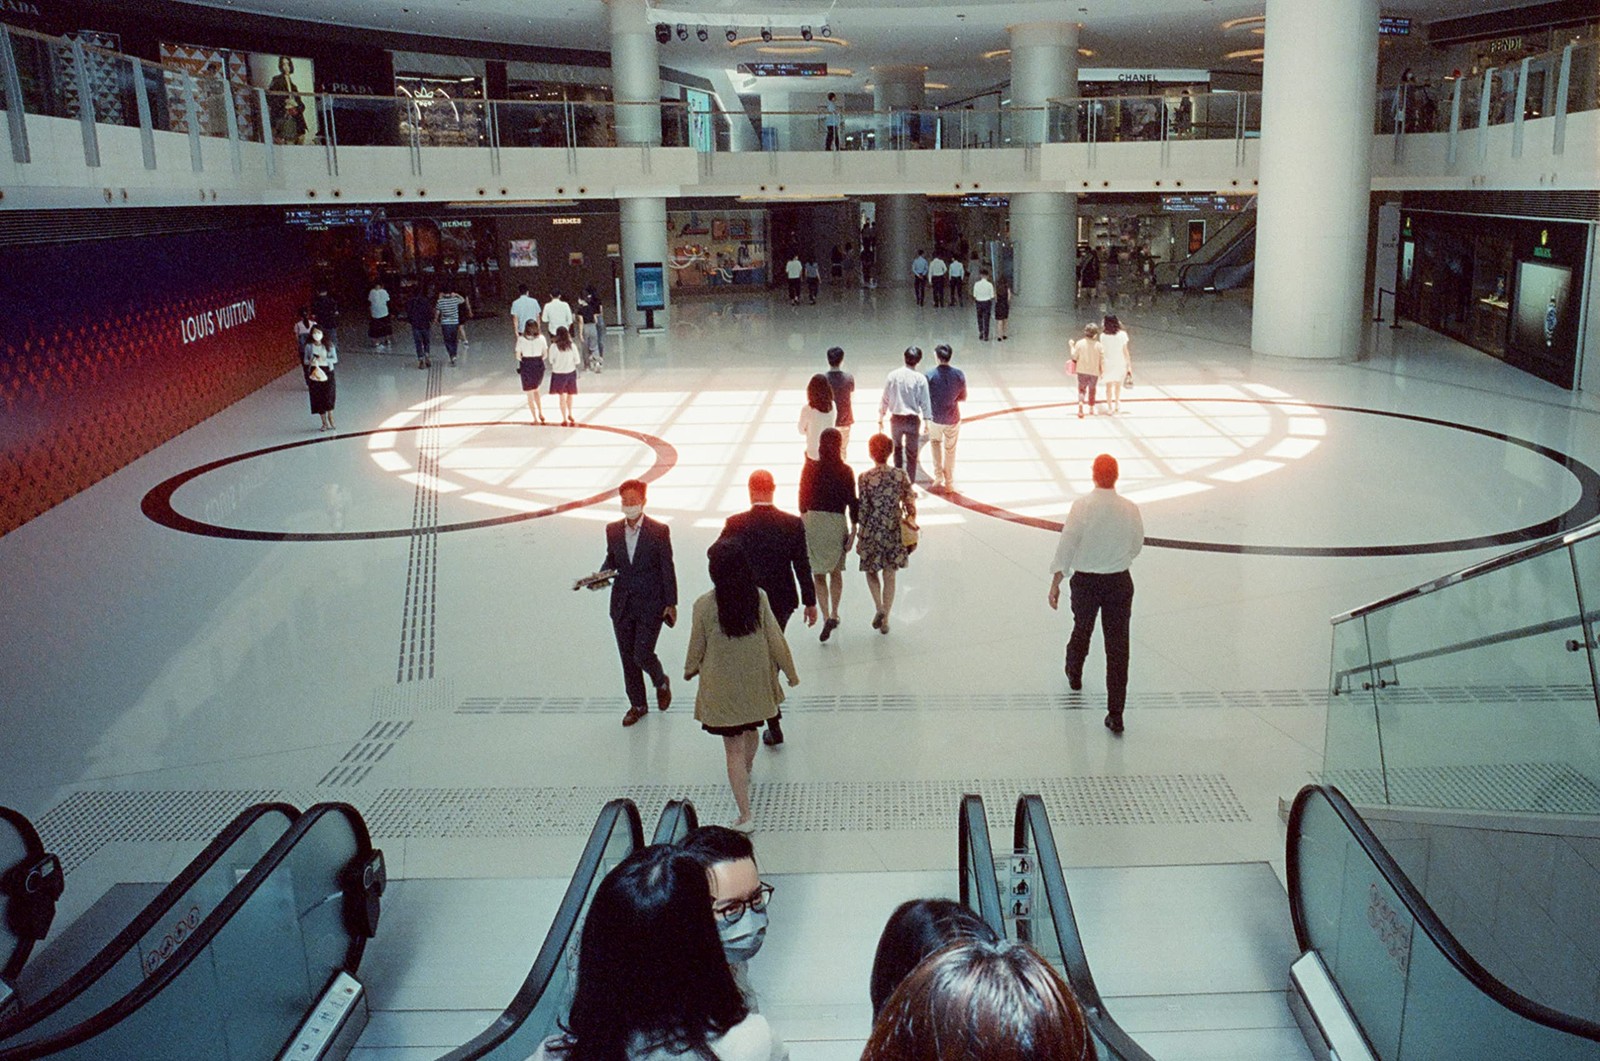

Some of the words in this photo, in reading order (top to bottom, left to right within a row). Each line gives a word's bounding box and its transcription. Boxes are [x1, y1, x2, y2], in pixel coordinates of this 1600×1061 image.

[1491, 36, 1522, 52] FENDI
[1118, 74, 1159, 82] CHANEL
[332, 82, 375, 95] PRADA
[181, 311, 215, 344] LOUIS
[215, 299, 256, 332] VUITTON
